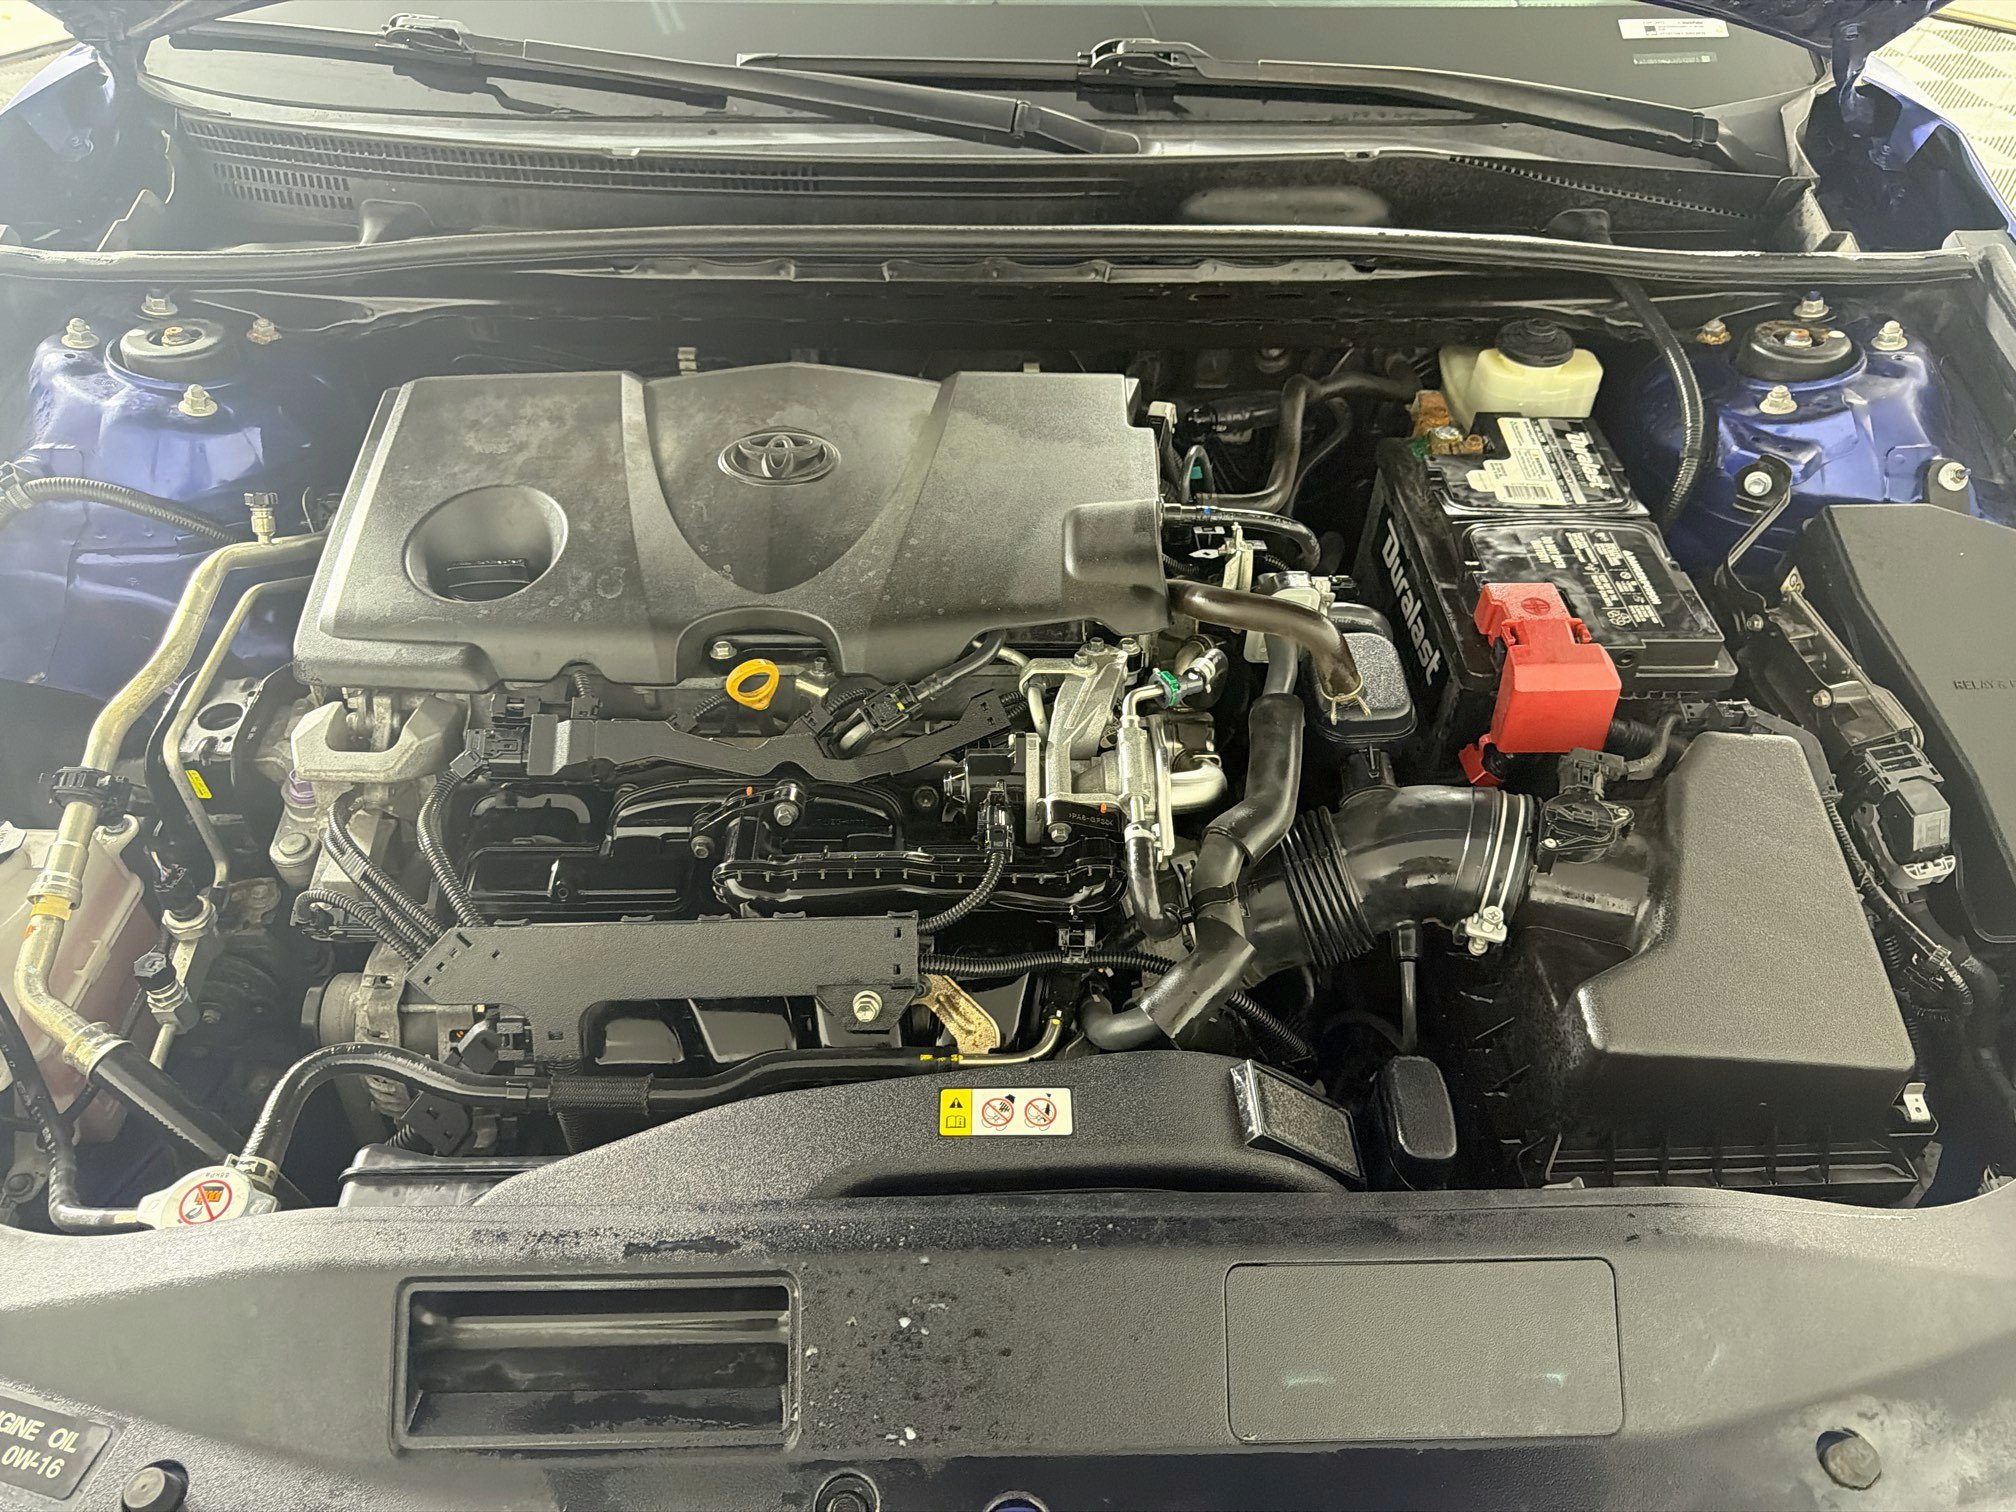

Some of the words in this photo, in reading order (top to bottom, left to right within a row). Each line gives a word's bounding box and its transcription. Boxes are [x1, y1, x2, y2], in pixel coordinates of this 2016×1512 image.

[1564, 432, 1611, 489] Duralast
[1381, 517, 1441, 687] Duralast
[1953, 680, 1993, 689] RELAY
[48, 1427, 80, 1453] OIL
[1, 1445, 65, 1479] 0W-16
